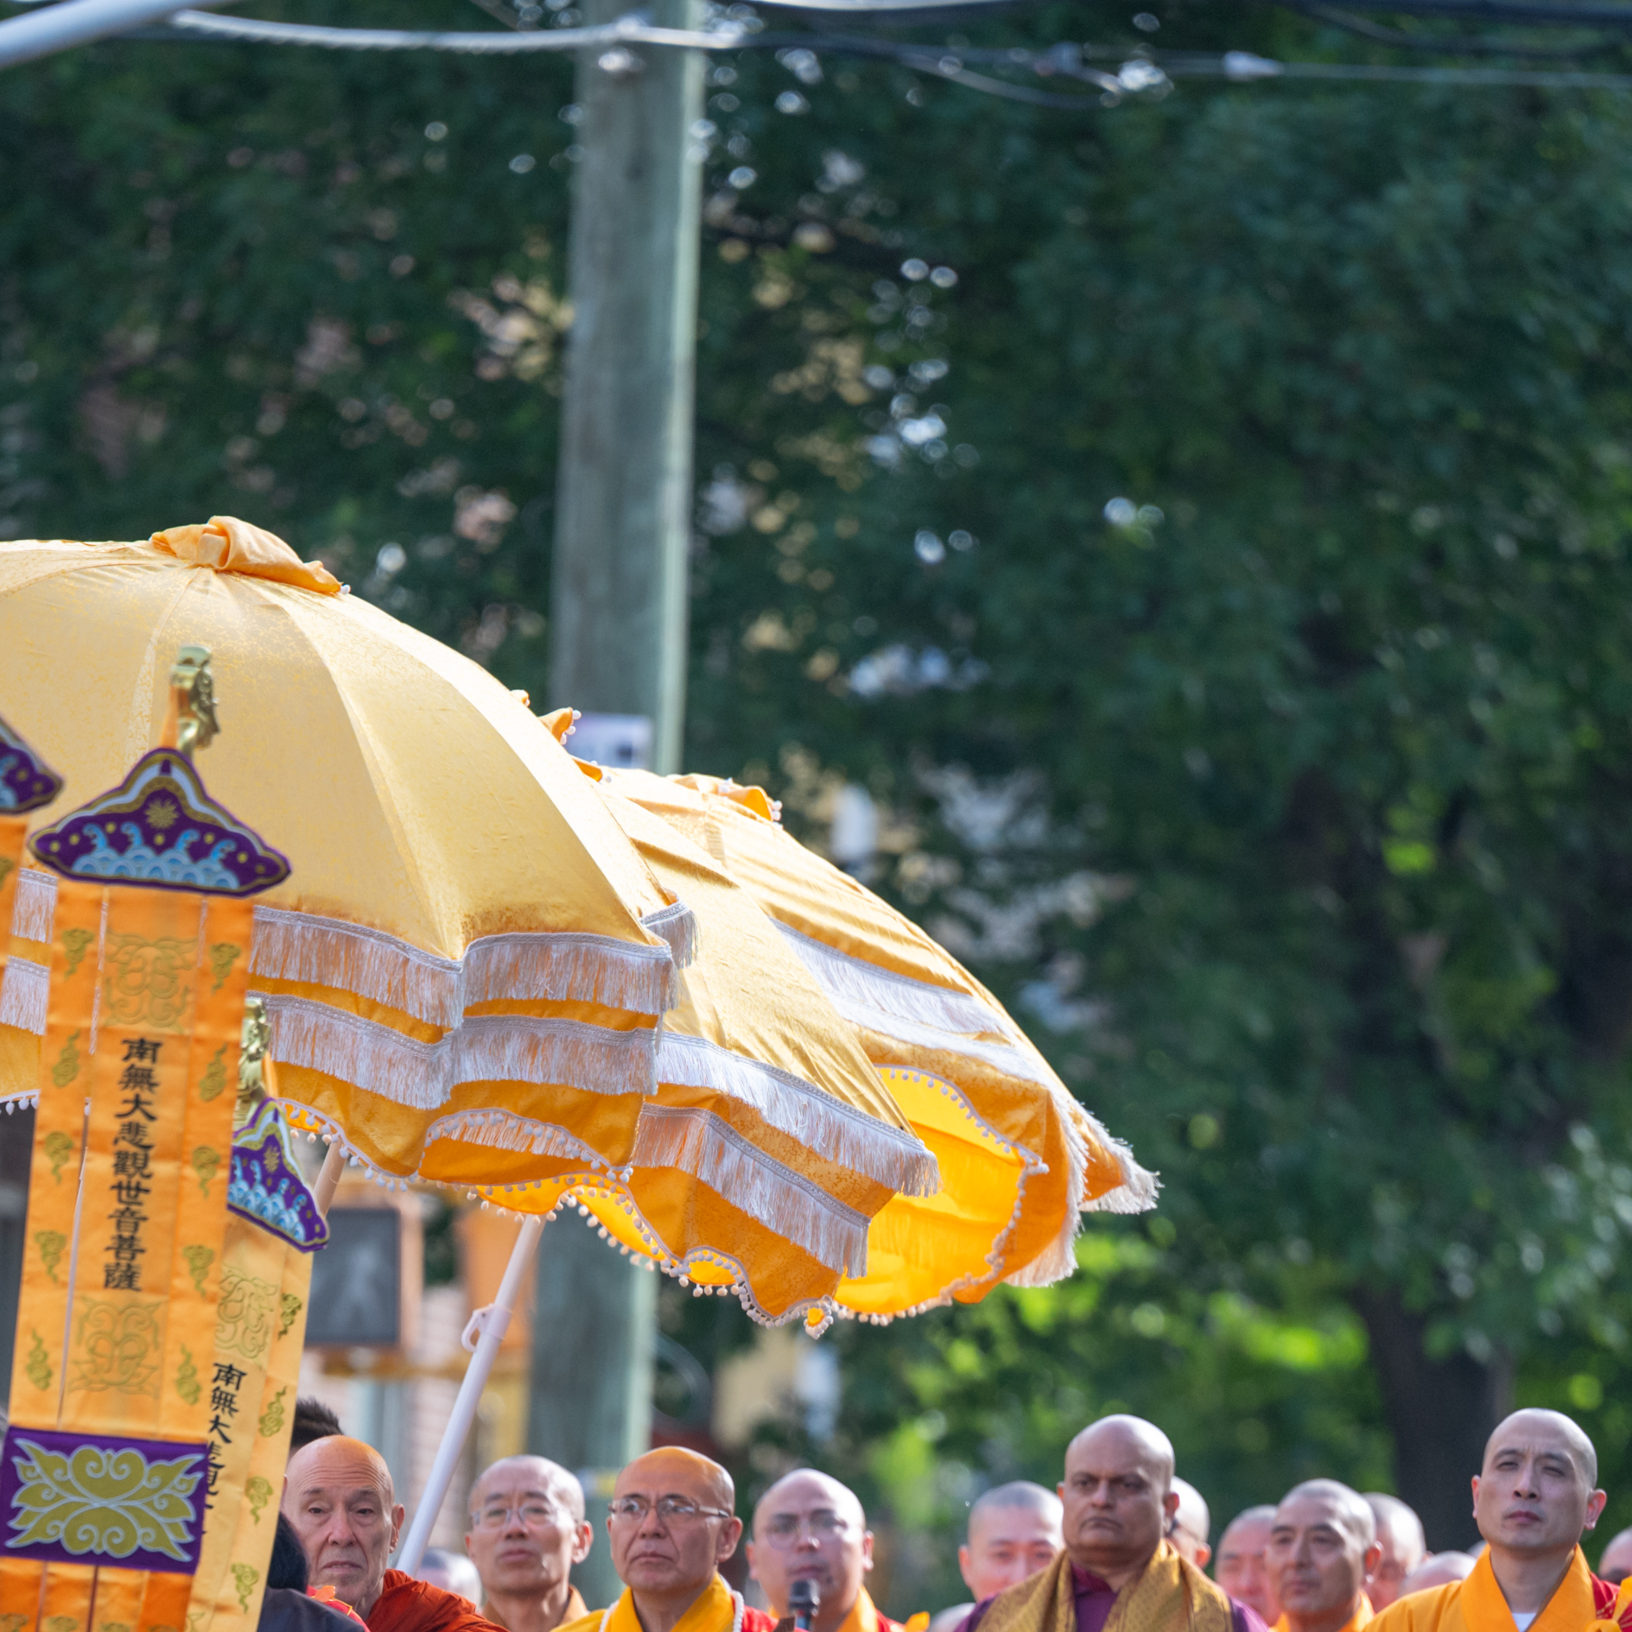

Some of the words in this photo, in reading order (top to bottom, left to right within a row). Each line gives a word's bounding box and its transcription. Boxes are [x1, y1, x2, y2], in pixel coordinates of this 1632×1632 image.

[104, 1038, 162, 1291] 南無大悲觀世音菩薩
